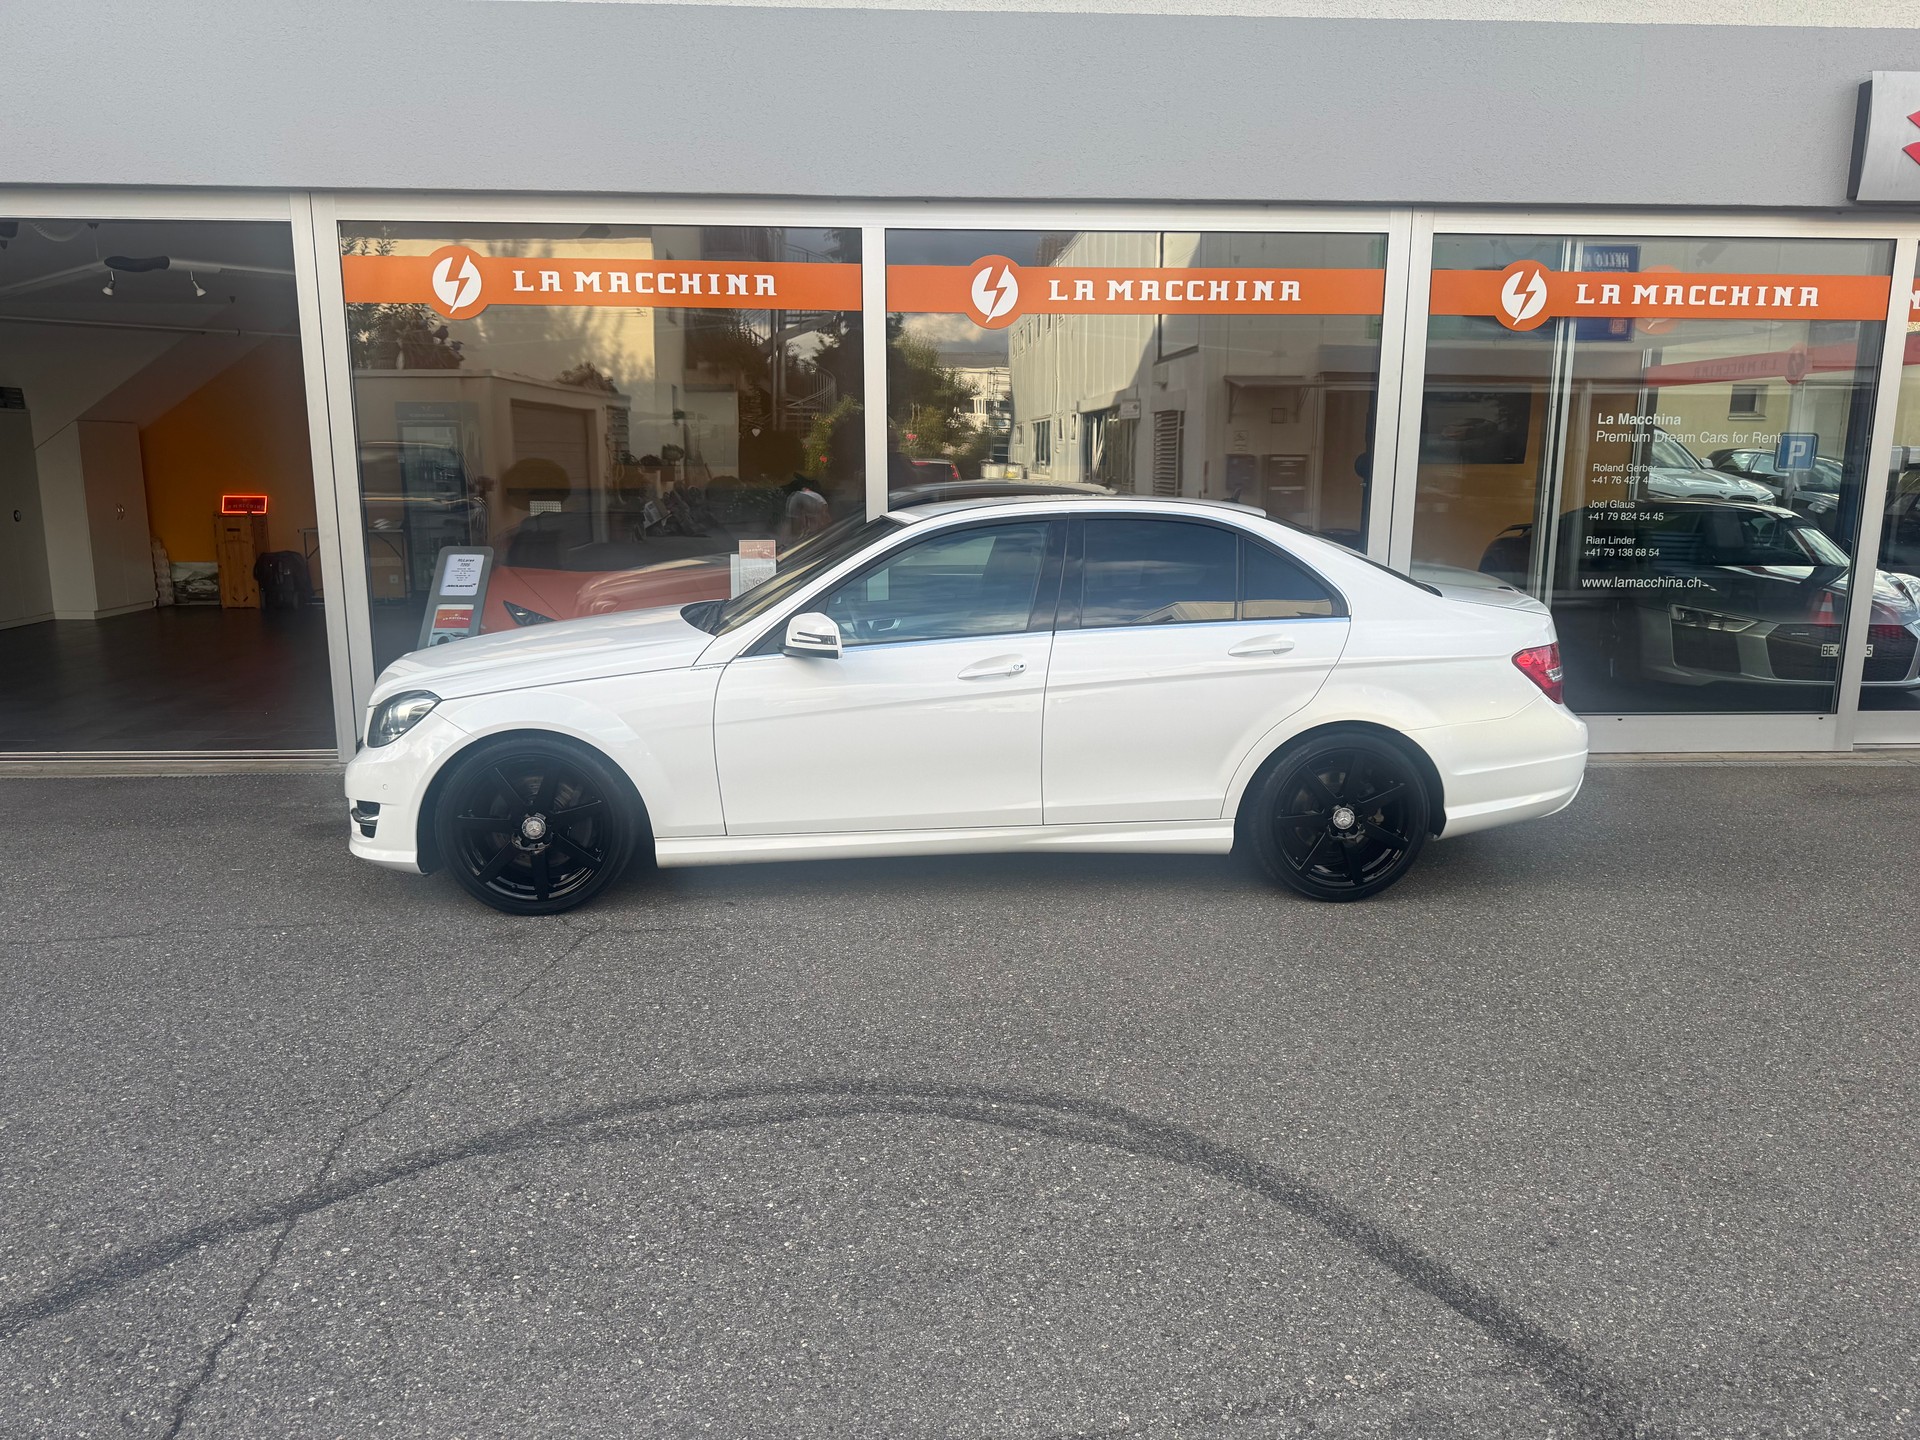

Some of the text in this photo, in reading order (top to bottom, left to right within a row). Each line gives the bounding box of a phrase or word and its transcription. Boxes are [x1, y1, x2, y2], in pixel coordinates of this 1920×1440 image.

[512, 270, 778, 296] LA MACCHINA
[1048, 279, 1302, 302] LA MACCHINA
[1575, 283, 1819, 307] LA MACCHINA
[1597, 412, 1682, 425] La Macchina
[1596, 430, 1782, 444] Premium Dream Cars for Rent
[1787, 440, 1807, 466] P
[1592, 463, 1657, 473] Roland Gerber
[1591, 475, 1608, 485] +41
[1611, 475, 1622, 485] 76
[1623, 475, 1641, 485] 427
[1588, 499, 1636, 509] Joel Glaus
[1588, 512, 1664, 521] +41 79 824 54 45
[1585, 535, 1636, 545] Rian Linder
[1584, 548, 1660, 557] +41 79 138 68 54
[1581, 576, 1702, 588] www.lamacchina.ch
